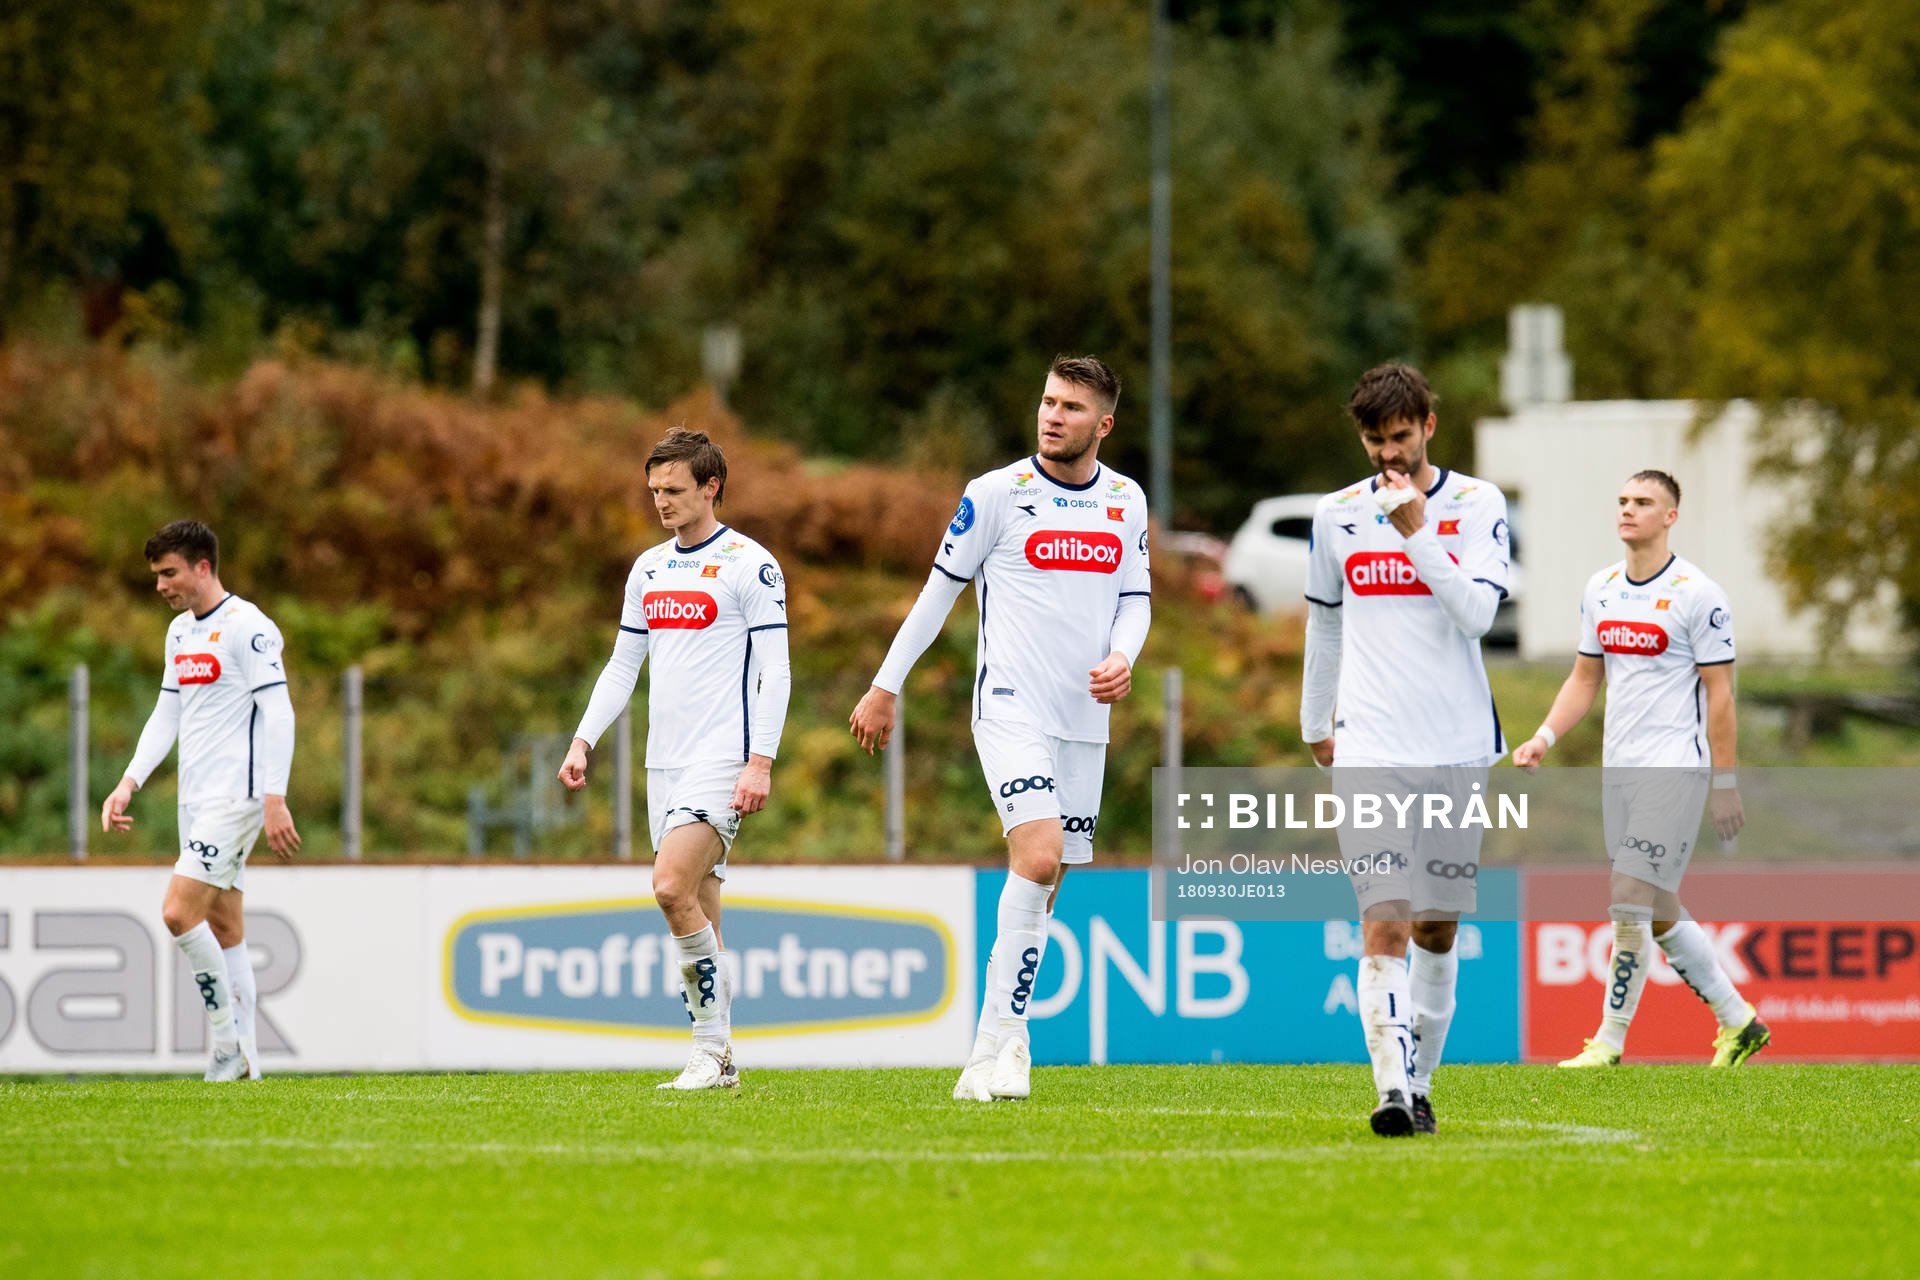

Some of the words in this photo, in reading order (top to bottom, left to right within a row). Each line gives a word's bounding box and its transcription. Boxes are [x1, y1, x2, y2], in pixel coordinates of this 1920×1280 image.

[1070, 499, 1098, 508] OBOS
[1035, 537, 1117, 564] altibox
[1351, 557, 1418, 586] altib
[645, 597, 707, 620] altibox
[1599, 625, 1660, 649] altibox
[1007, 803, 1014, 812] 6
[1426, 859, 1478, 879] coo
[1011, 946, 1039, 1016] coop
[1609, 950, 1639, 1010] coop
